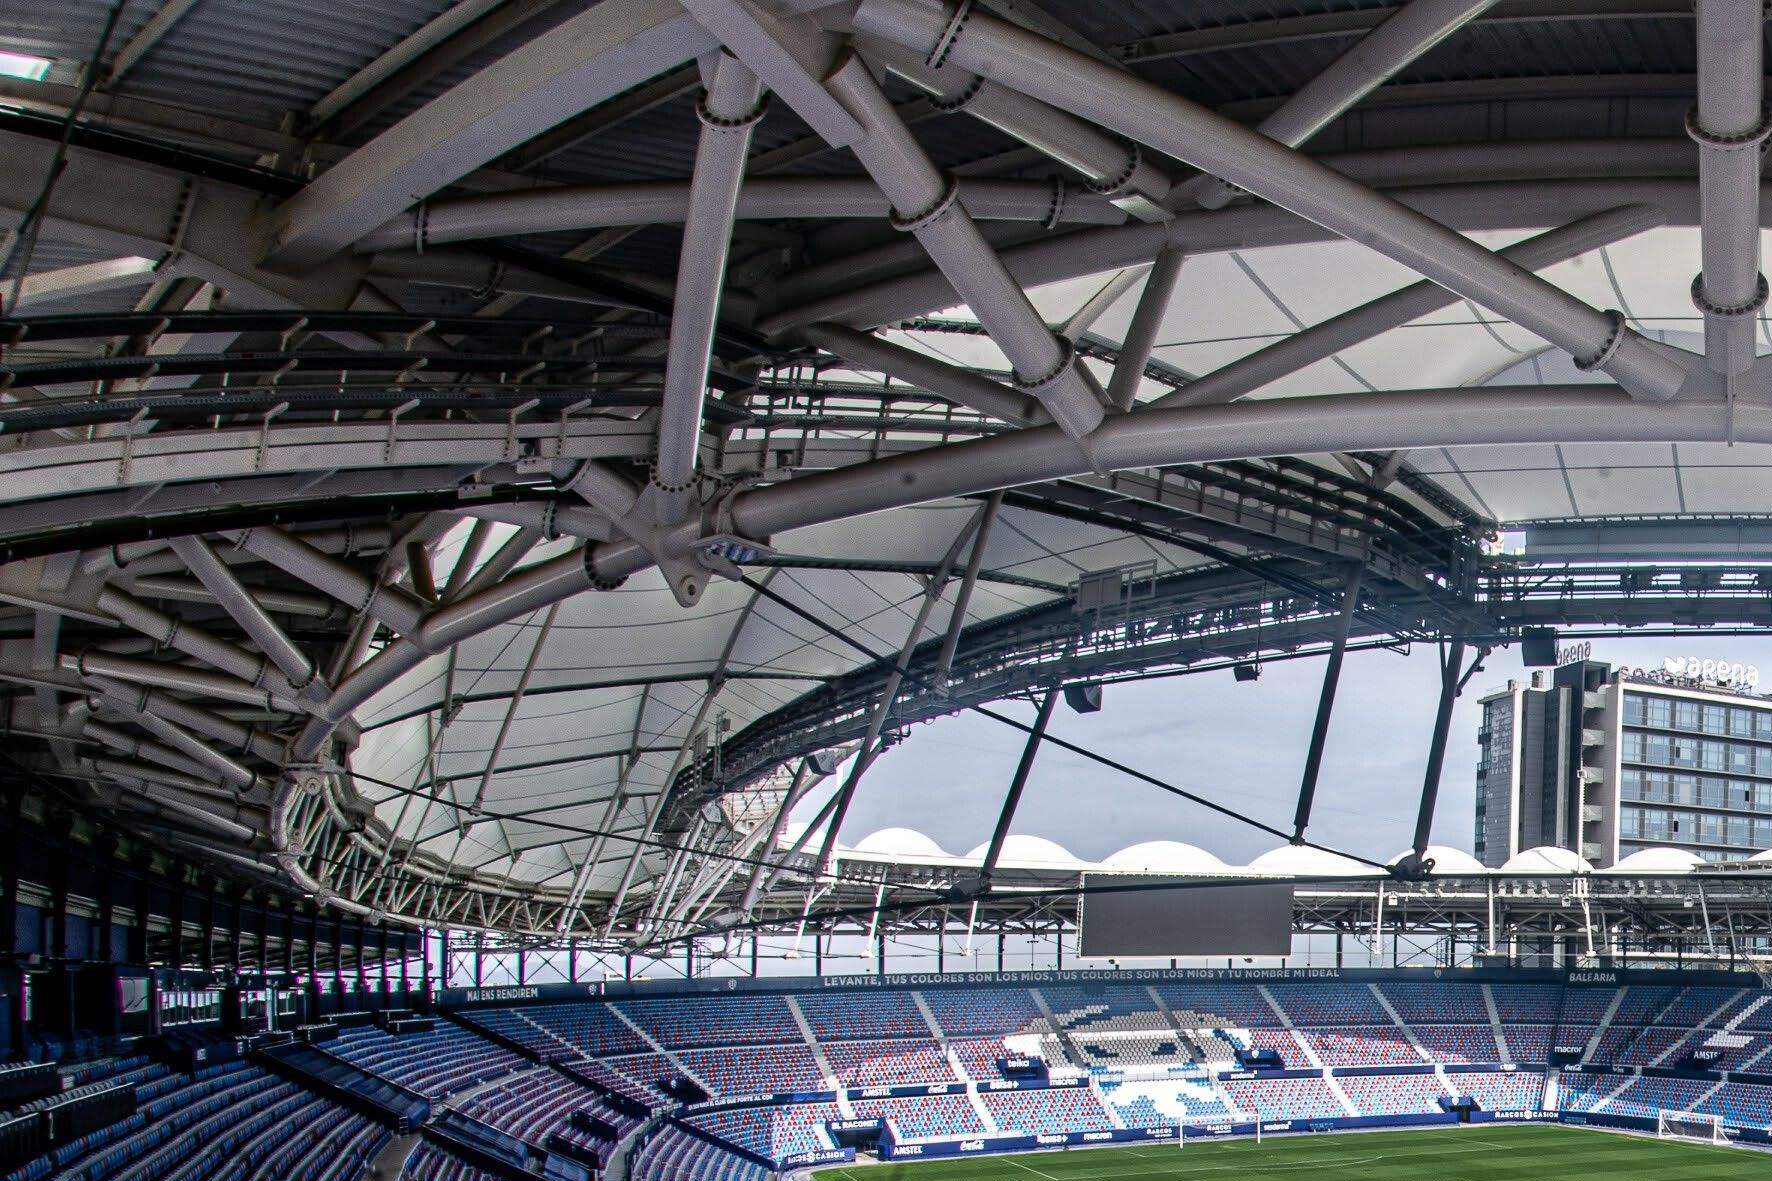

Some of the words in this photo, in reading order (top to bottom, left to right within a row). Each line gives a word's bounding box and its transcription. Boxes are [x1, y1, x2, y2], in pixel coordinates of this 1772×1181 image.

[1687, 656, 1759, 687] arena
[824, 975, 882, 987] LEVANTE,
[885, 974, 907, 986] TUS
[911, 973, 964, 984] COLORES
[968, 972, 992, 983] SON
[996, 972, 1018, 982] LOS
[1056, 971, 1077, 980] TUS
[1081, 970, 1133, 980] COLORES
[1137, 970, 1159, 979] SON
[1163, 969, 1183, 978] LOS
[1218, 969, 1225, 978] Y
[1229, 969, 1242, 978] TU
[1245, 969, 1290, 978] NOMBRE
[1293, 969, 1305, 978] MI
[1309, 968, 1340, 977] IDEAL
[481, 990, 495, 1000] ENS
[496, 987, 538, 1000] RENDIREM
[831, 1121, 841, 1130] EL
[843, 1120, 879, 1128] RACONET
[893, 1145, 924, 1155] AMSTEL
